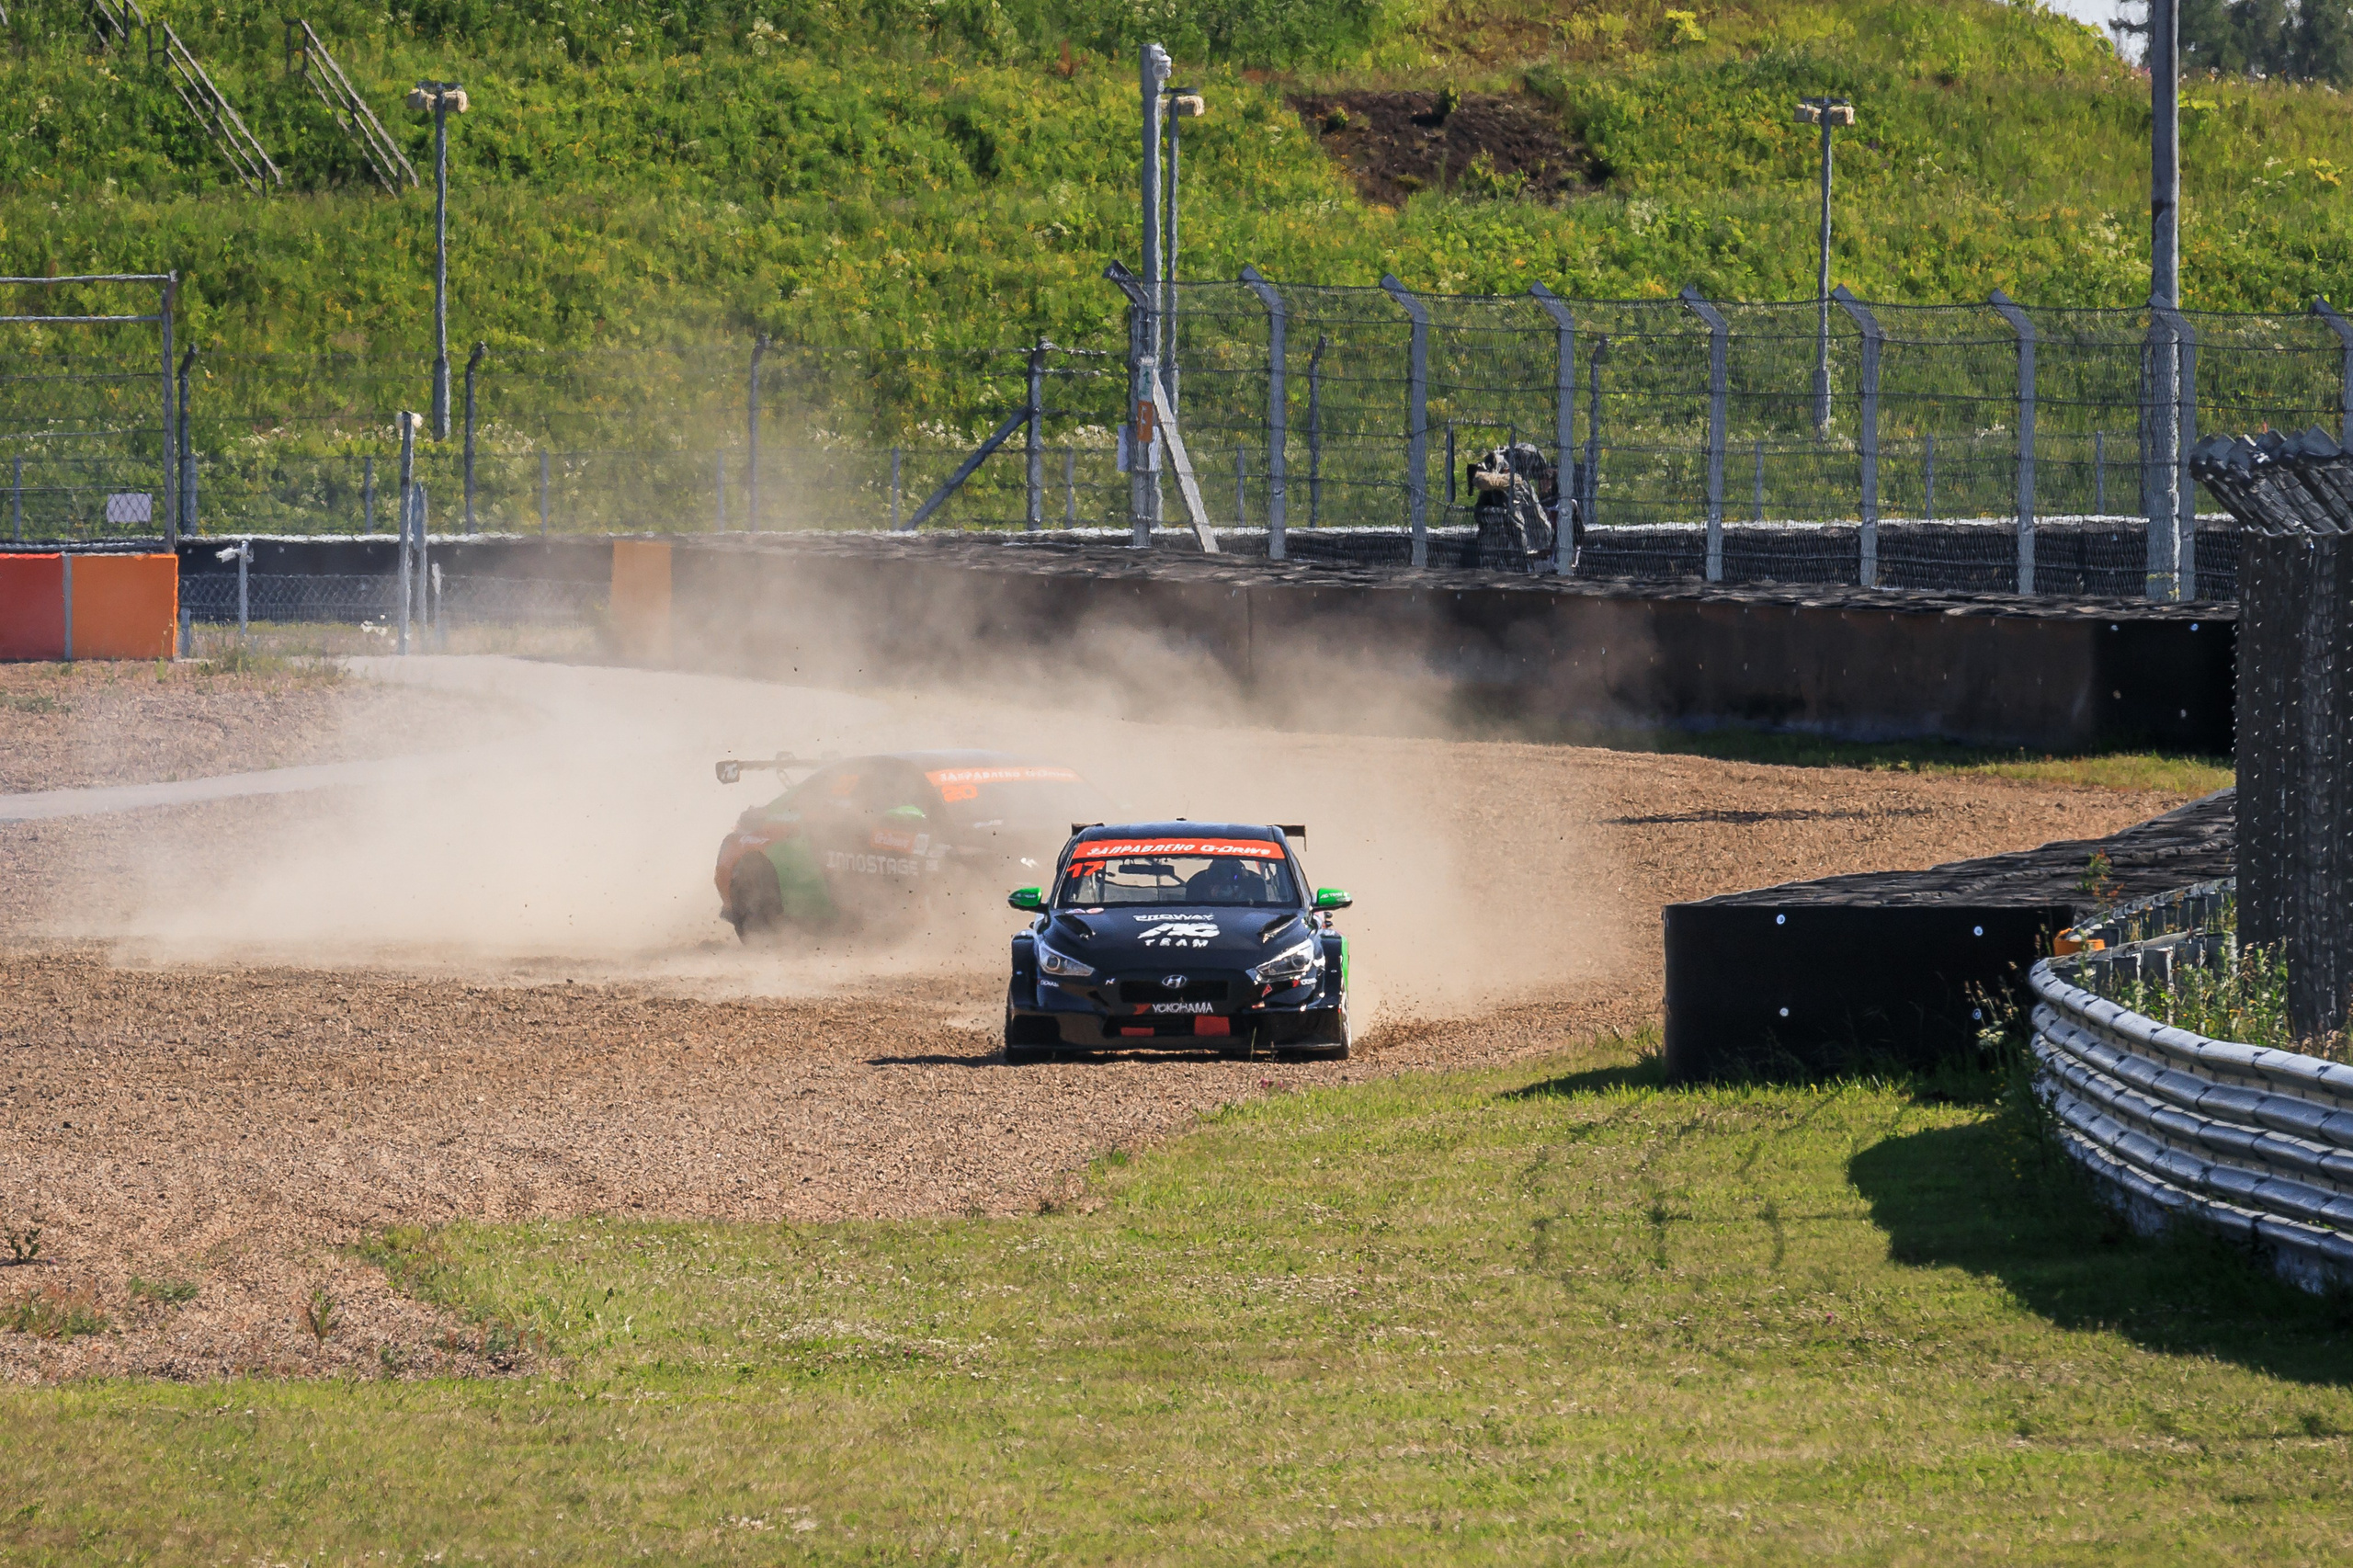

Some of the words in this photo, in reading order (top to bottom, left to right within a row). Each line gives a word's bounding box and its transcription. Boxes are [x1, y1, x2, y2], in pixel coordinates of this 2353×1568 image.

[1086, 844, 1196, 856] ЗАПРАВЛЕНО
[1066, 860, 1106, 878] 17
[1144, 937, 1209, 948] TEAM
[1152, 1001, 1214, 1013] YOKOHAMA
